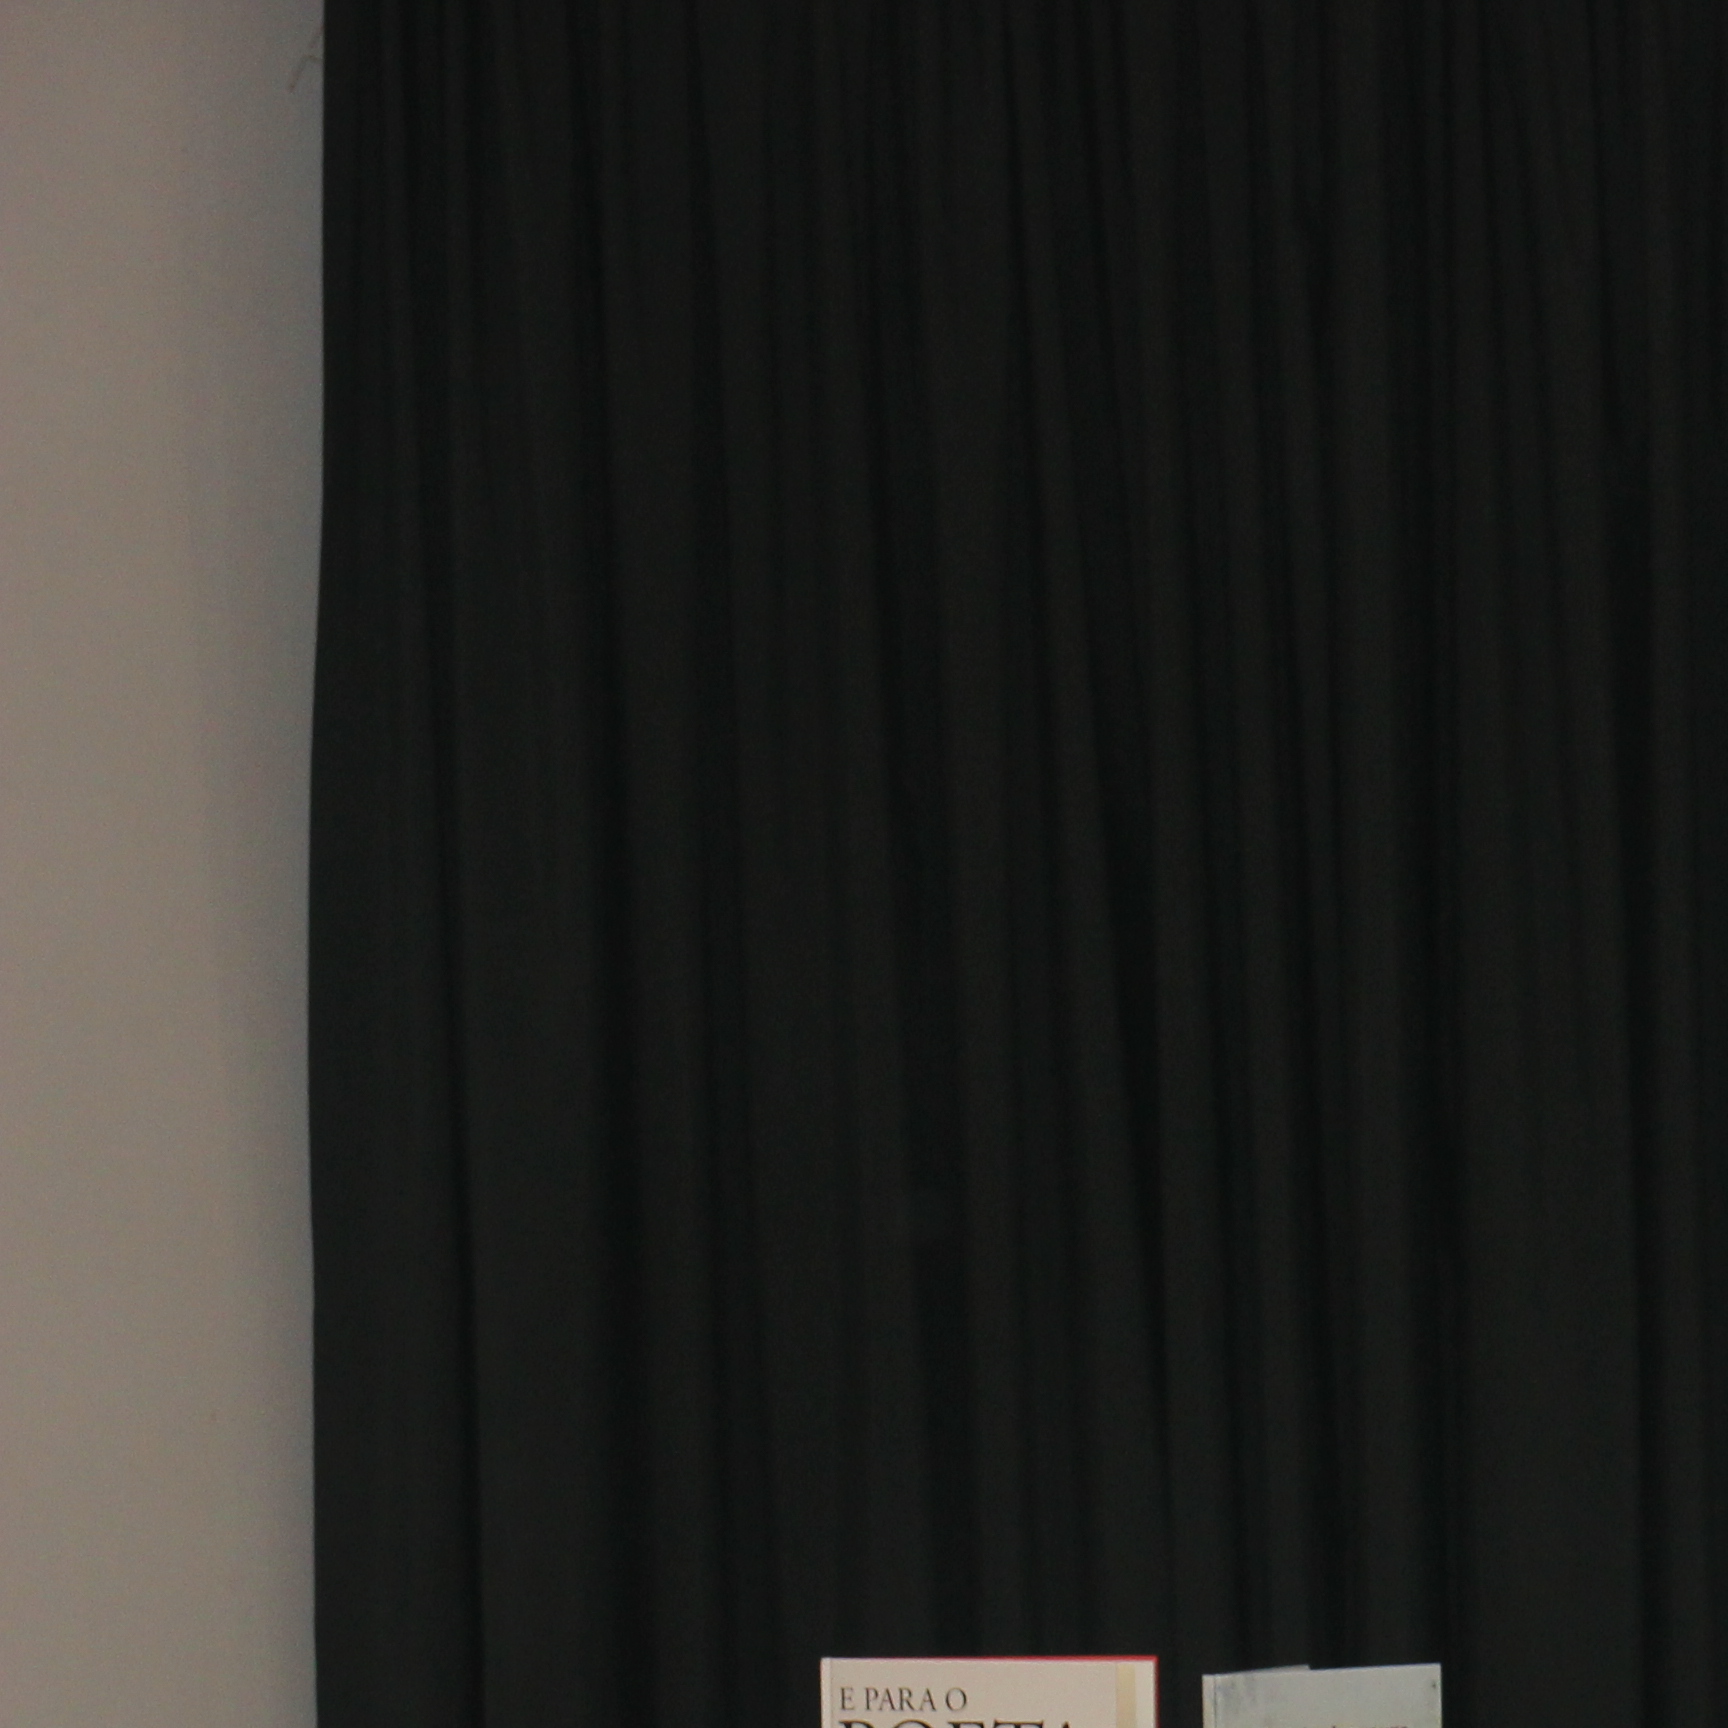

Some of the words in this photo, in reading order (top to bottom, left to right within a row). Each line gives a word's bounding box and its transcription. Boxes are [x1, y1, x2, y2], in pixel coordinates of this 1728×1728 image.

[840, 1687, 855, 1711] E
[864, 1687, 937, 1712] PARA
[945, 1687, 968, 1712] O
